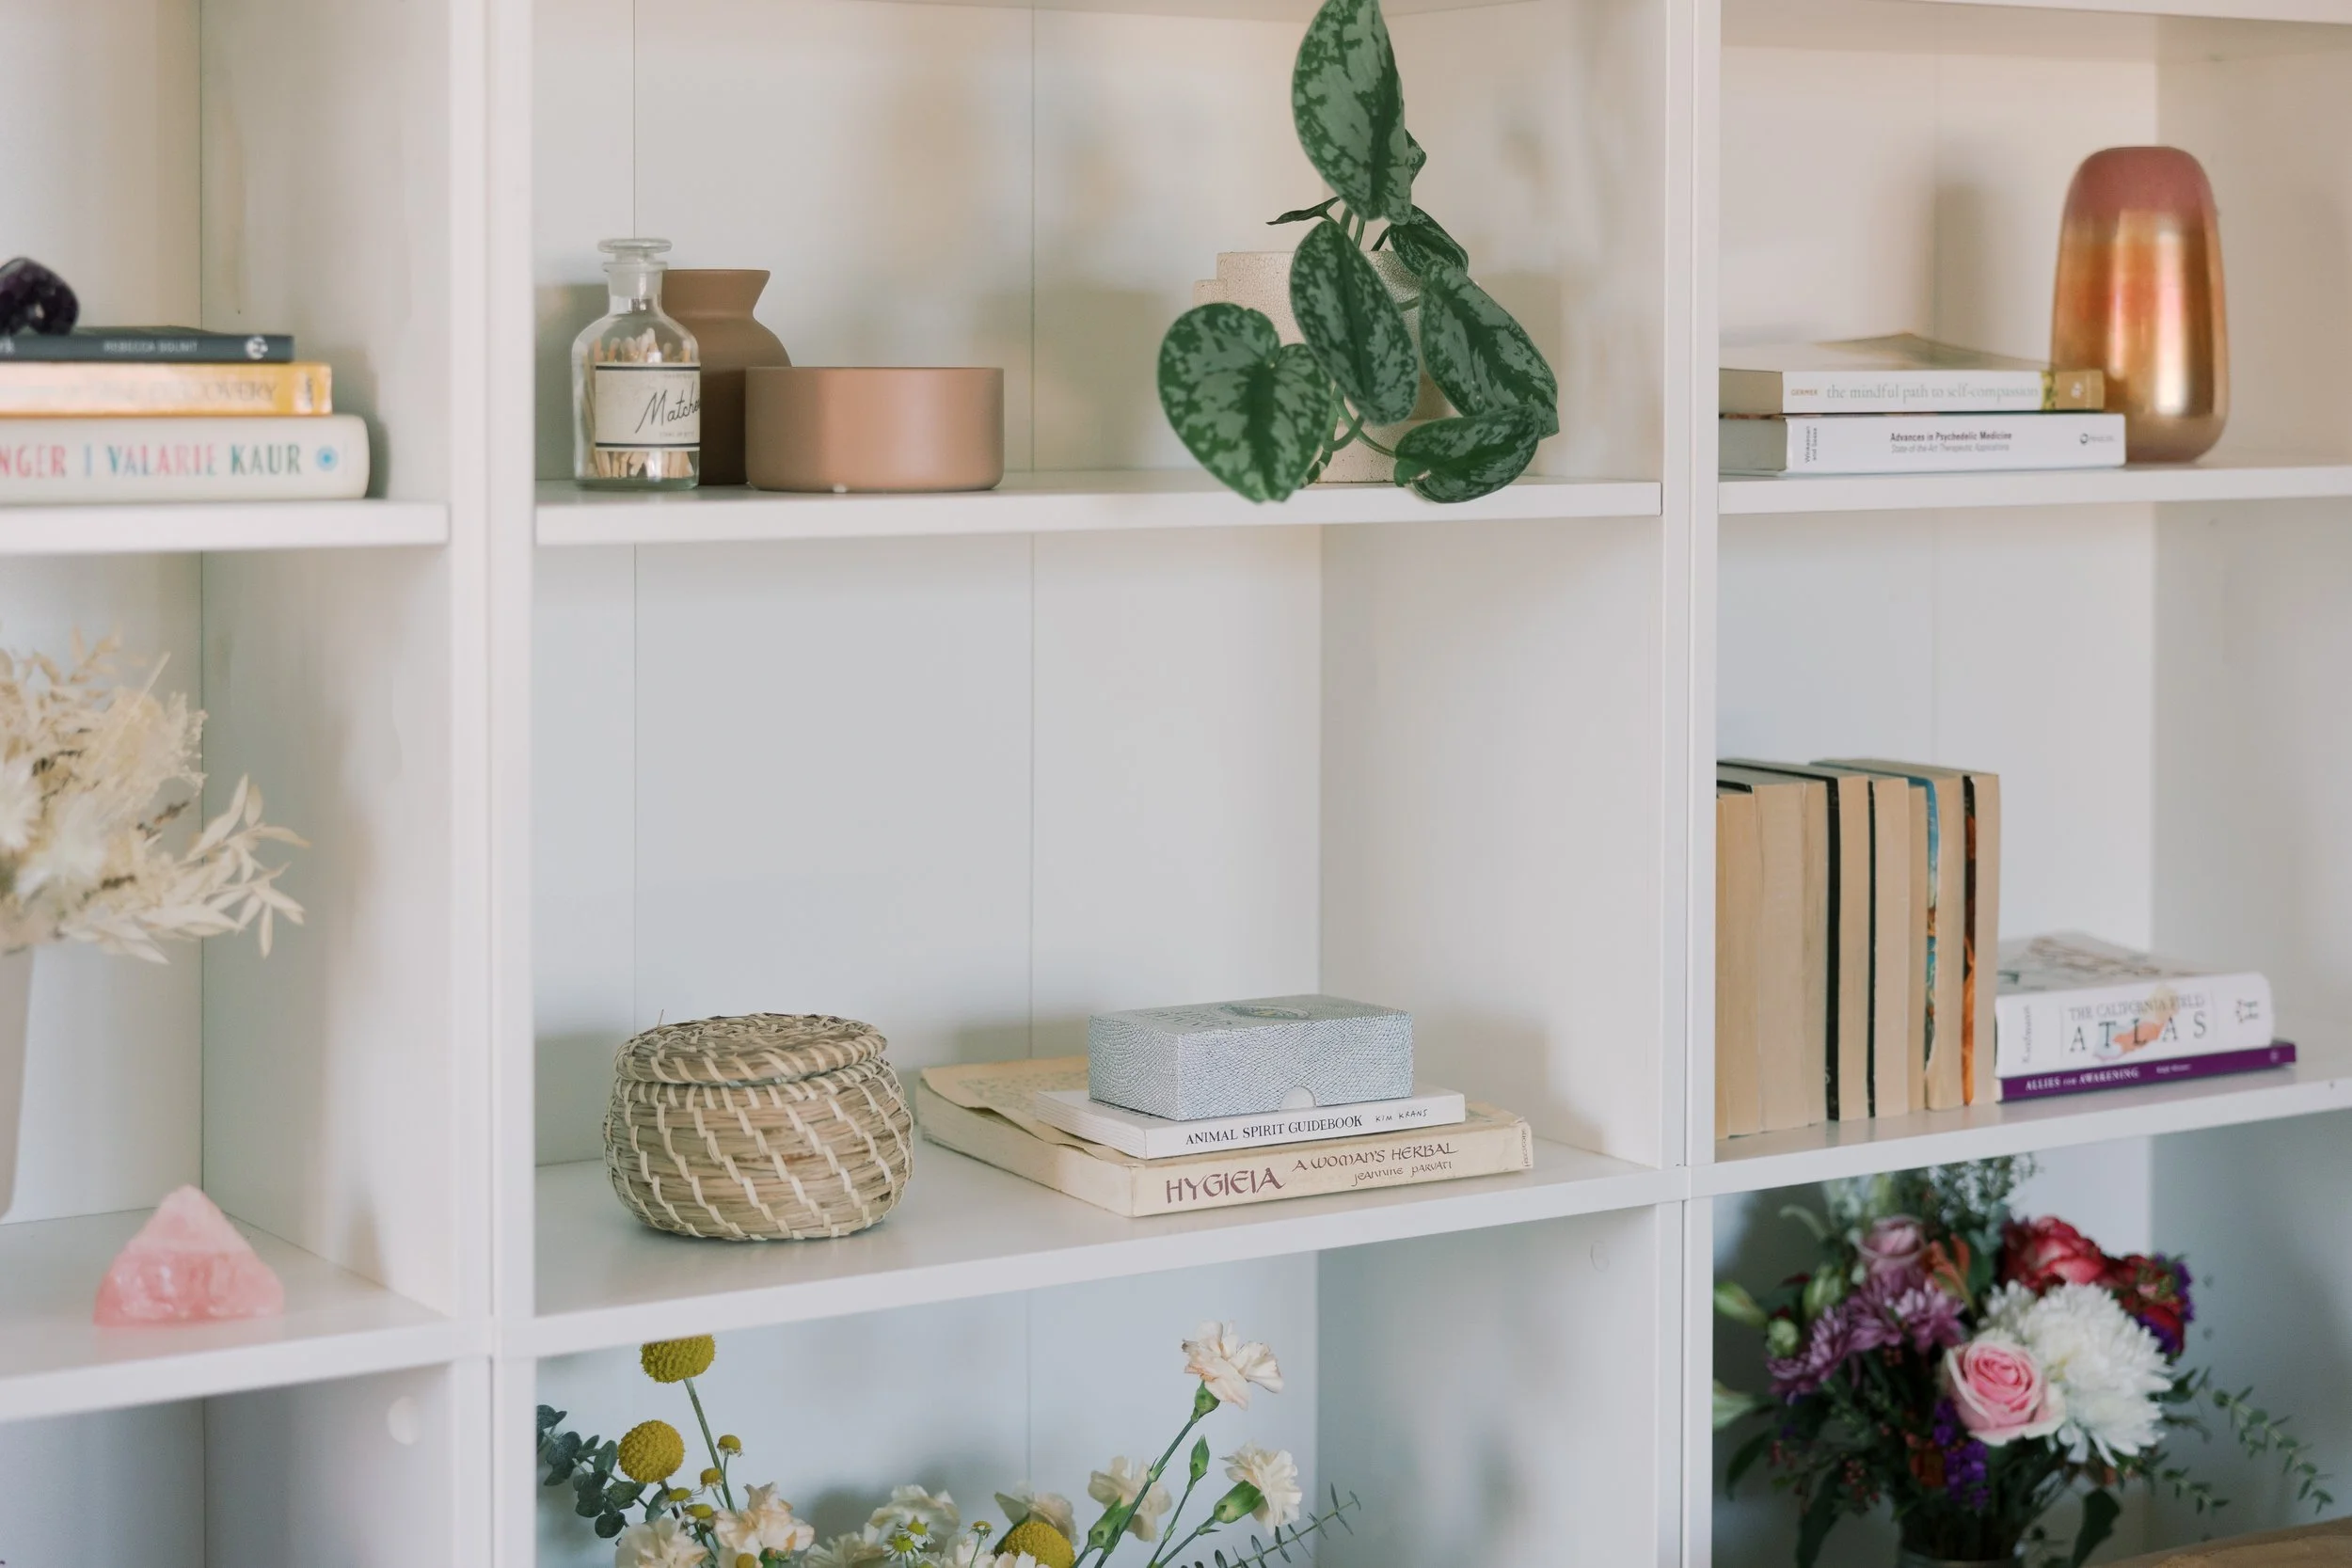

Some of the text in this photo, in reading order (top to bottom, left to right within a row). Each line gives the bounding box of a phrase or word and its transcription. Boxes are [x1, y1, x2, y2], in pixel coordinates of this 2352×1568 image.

[635, 378, 700, 434] Matche
[1827, 382, 2039, 404] the mindful path to self-compassion
[1890, 432, 1925, 442] Advances
[1935, 431, 1976, 442] Psychedelic
[1979, 431, 2012, 440] Medicine
[0, 444, 302, 478] NGER VALARIE KAUR
[2069, 1006, 2094, 1022] THE
[2070, 1011, 2207, 1053] ATLAS
[2026, 1075, 2061, 1091] ALLIES
[2079, 1067, 2140, 1085] AWAKENING
[1185, 1108, 1429, 1145] ANIMAL SPIRIT GUIDEBOOK KIM KRANS
[1166, 1167, 1287, 1204] HYGIEIA
[1292, 1159, 1308, 1172] A
[1391, 1142, 1459, 1162] HERBAL
